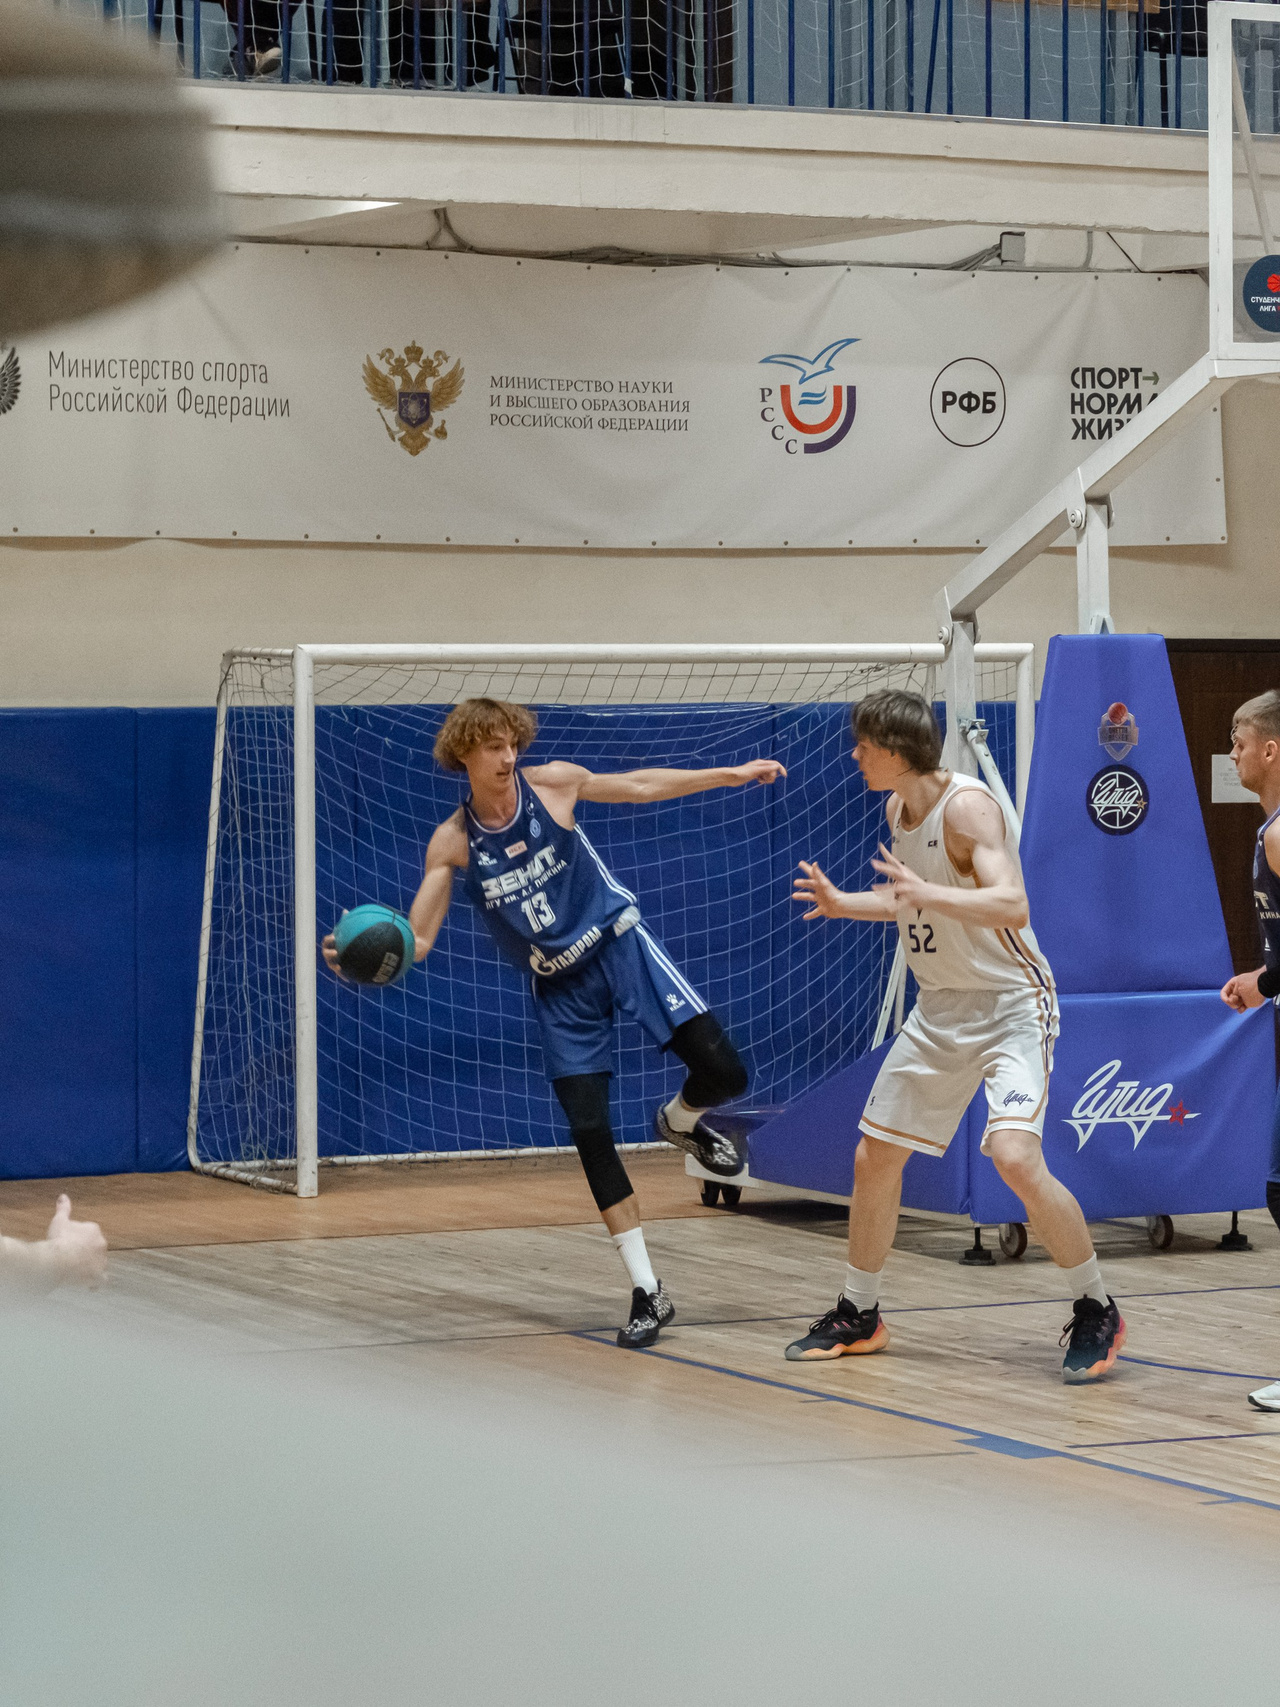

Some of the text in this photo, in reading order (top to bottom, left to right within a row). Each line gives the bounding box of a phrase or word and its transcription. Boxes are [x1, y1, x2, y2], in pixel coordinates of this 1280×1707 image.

[48, 350, 269, 389] Министерство спорта
[1070, 367, 1142, 389] СПОРТ
[490, 375, 674, 395] МИНИСТЕРСТВО НАУКИ
[49, 384, 291, 422] Российской Федерации
[490, 394, 691, 414] И ВЫСШЕГО ОБРАЗОВАНИЯ
[941, 391, 997, 414] РФБ
[489, 412, 689, 433] РОССИЙСКОЙ ФЕДЕРАЦИИ
[481, 844, 556, 900] ЗЕНИТ
[521, 891, 557, 934] 13
[551, 925, 603, 970] ГАЗПРОМ
[908, 924, 937, 953] 52
